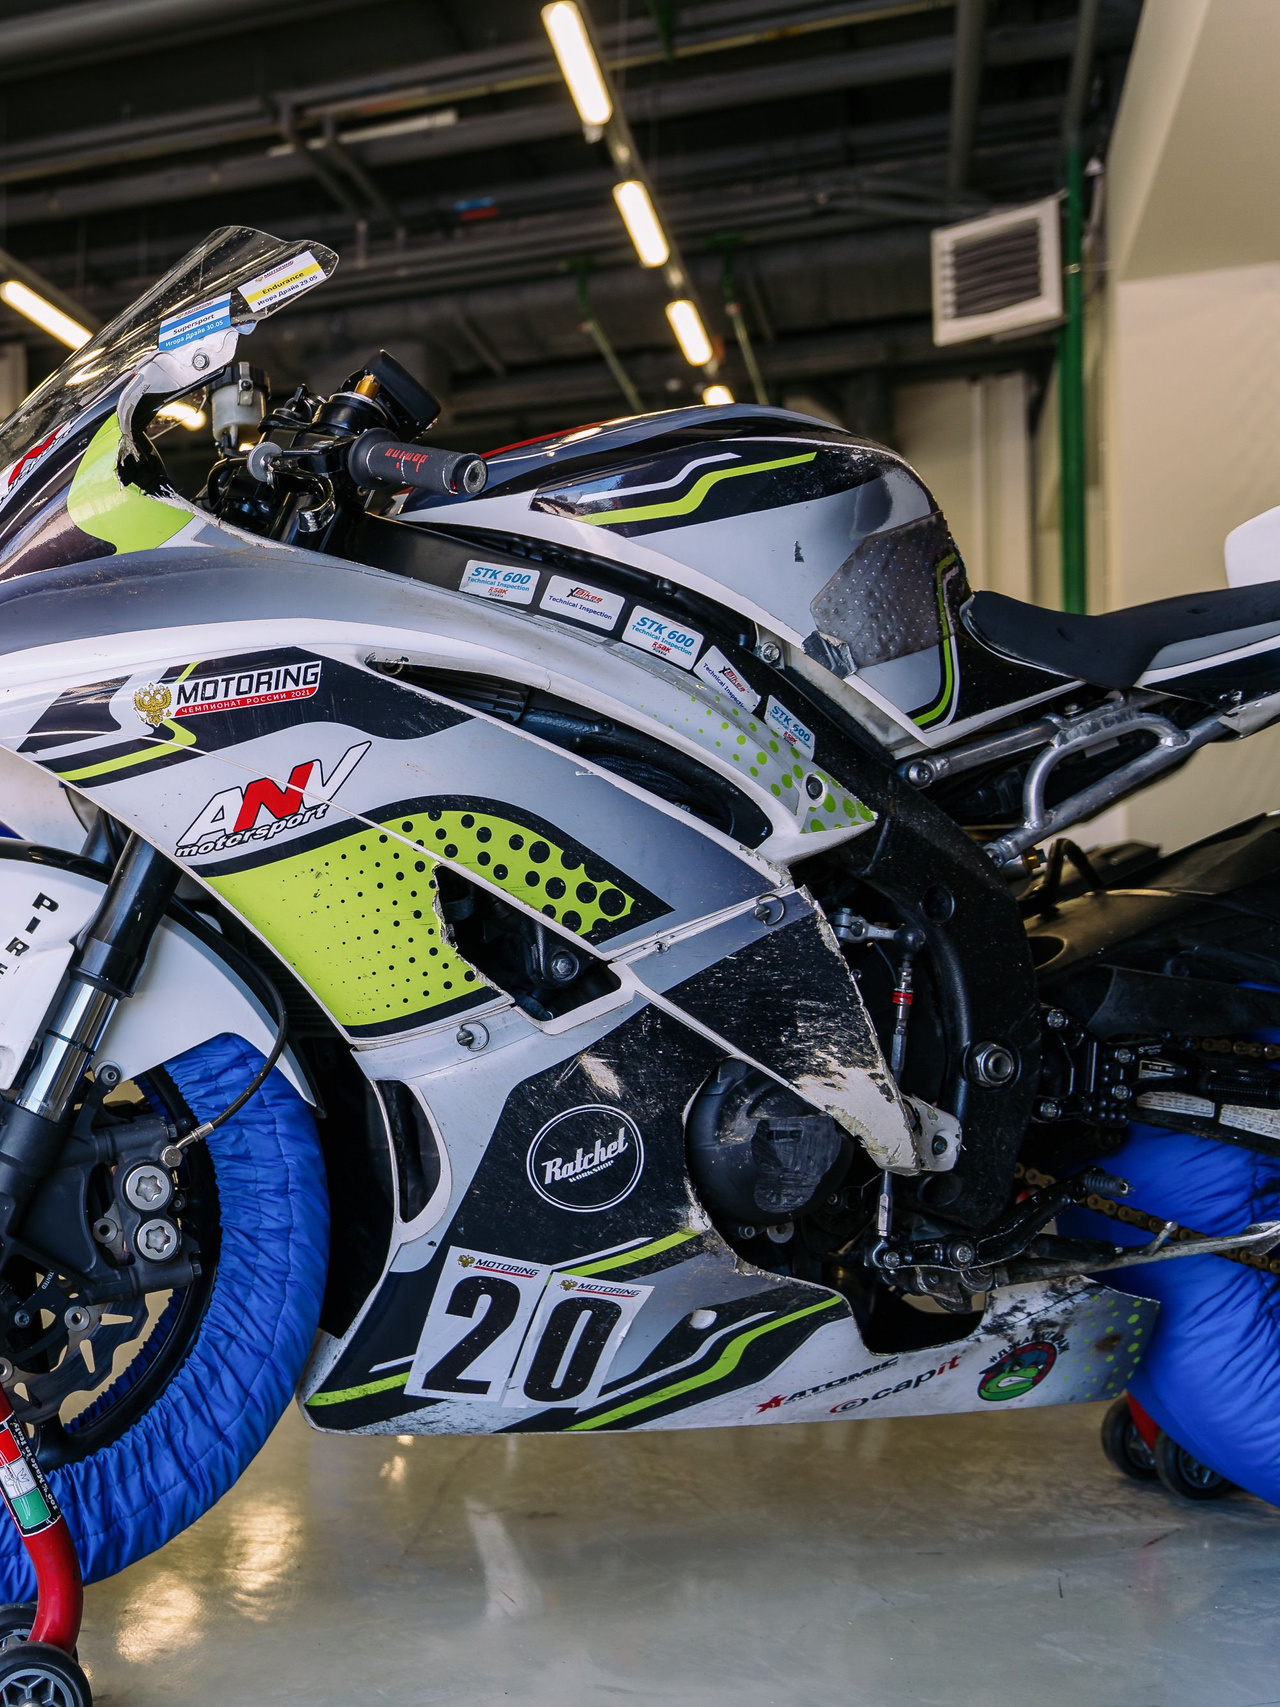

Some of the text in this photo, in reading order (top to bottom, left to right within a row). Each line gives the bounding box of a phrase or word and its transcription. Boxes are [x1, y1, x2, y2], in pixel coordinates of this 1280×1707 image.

[257, 275, 318, 306] Игора Драйв 29.05
[262, 272, 305, 295] Endurance
[165, 320, 224, 348] Игора Драйв 30.05
[173, 314, 215, 335] Supersport
[385, 448, 428, 472] domino
[467, 576, 530, 592] Technical Inspection
[471, 567, 532, 585] STK 600
[549, 595, 612, 620] Technical Inspection
[632, 624, 692, 656] Technical Inspection
[636, 616, 695, 648] STK 600
[176, 663, 320, 706] MOTORING
[703, 663, 725, 689] Technical
[181, 689, 311, 714] ЧЕМПИОНАТ РОССИИ 2021
[771, 705, 792, 725] STK
[792, 724, 811, 742] 600
[175, 803, 330, 857] motorsport
[541, 1127, 628, 1185] Ratchet
[568, 1160, 614, 1183] WORKSHOP
[475, 1258, 540, 1276] MOTORING
[577, 1282, 642, 1297] MOTORING
[784, 1356, 899, 1402] ATOMIC
[871, 1355, 962, 1401] capit
[24, 1444, 33, 1458] in
[30, 1457, 47, 1485] Made
